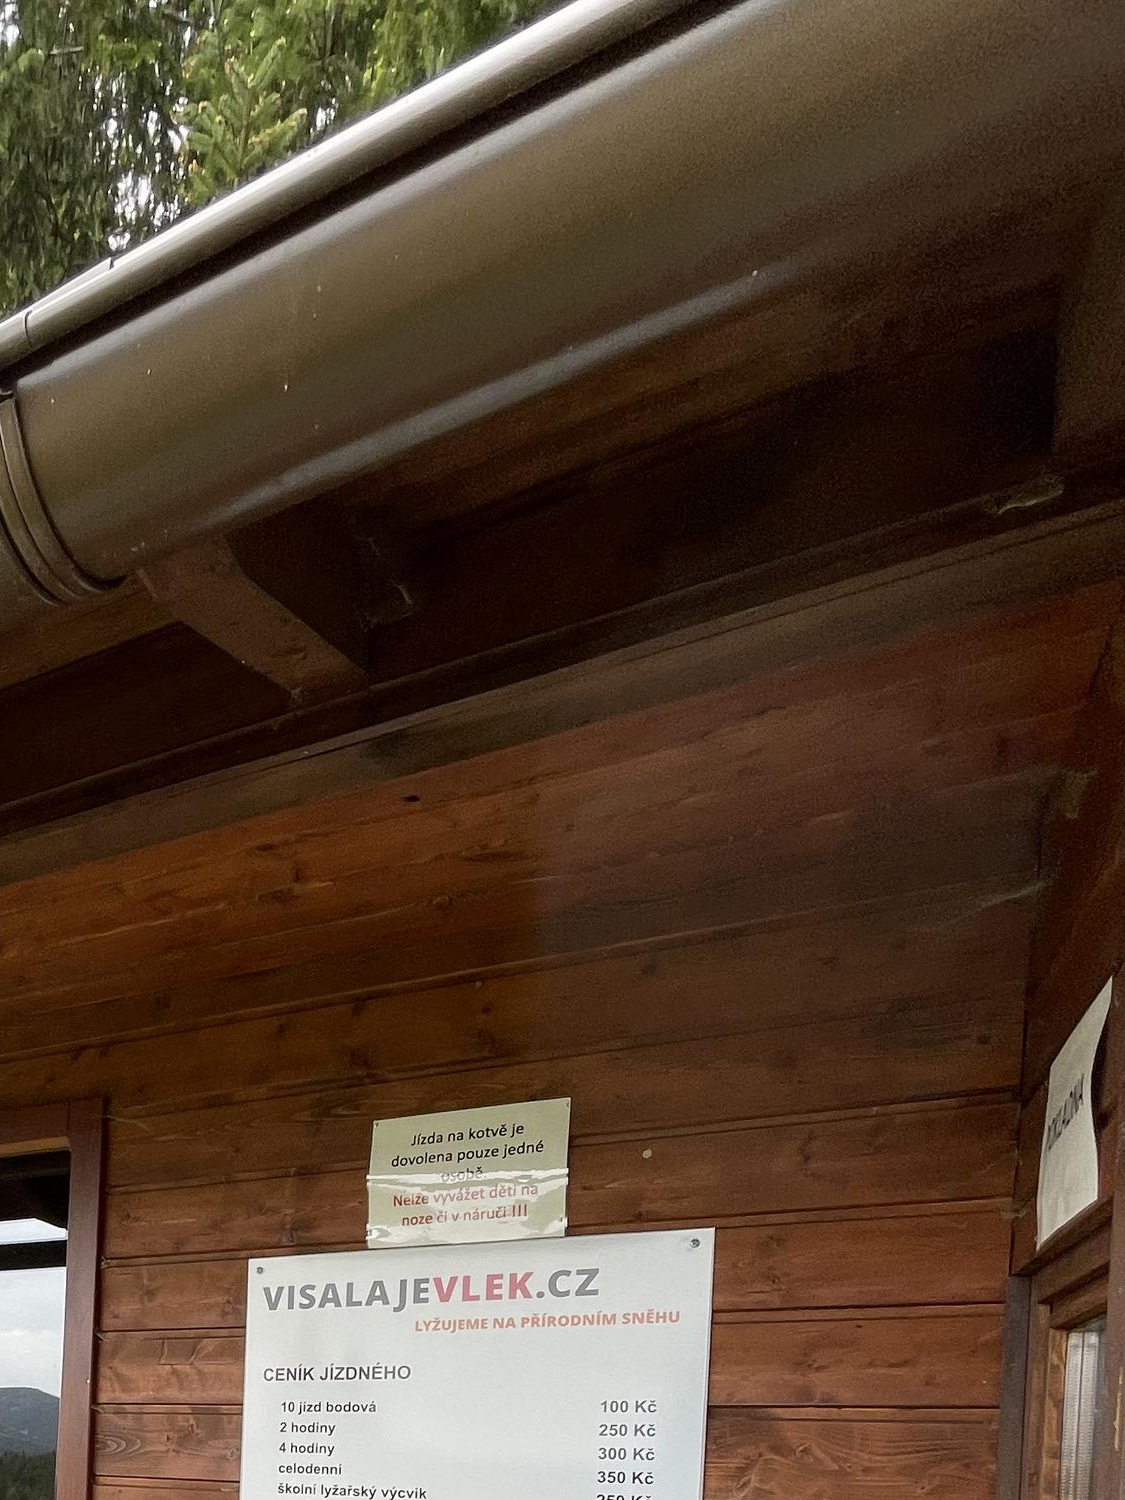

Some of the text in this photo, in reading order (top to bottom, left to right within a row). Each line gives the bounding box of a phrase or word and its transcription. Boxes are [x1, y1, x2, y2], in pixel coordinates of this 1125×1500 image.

[411, 1123, 524, 1147] Jízda na kotvě je
[391, 1140, 544, 1168] dovolena pouze jedné
[433, 1187, 485, 1205] vyvážet
[489, 1184, 516, 1198] děti
[521, 1185, 539, 1196] na
[401, 1215, 433, 1226] noze
[451, 1212, 460, 1222] v
[463, 1206, 507, 1221] náruči
[263, 1267, 600, 1313] VISALAJEVLEK.CZ
[415, 1308, 680, 1333] LYŽUJEME NA PŘÍRODNÍM SNĚHU
[263, 1362, 412, 1382] CENÍK JÍZDNÉHO
[281, 1401, 377, 1415] 10 jízd bodová
[600, 1400, 658, 1413] 100 Kč
[279, 1421, 336, 1436] 2 hodiny
[598, 1424, 656, 1437] 250 Kč
[278, 1442, 335, 1457] 4 hodiny
[598, 1447, 655, 1461] 300 Kč
[278, 1462, 343, 1475] celodenní
[597, 1471, 654, 1485] 350 Kč
[277, 1482, 427, 1500] školní lyžařský výcvik
